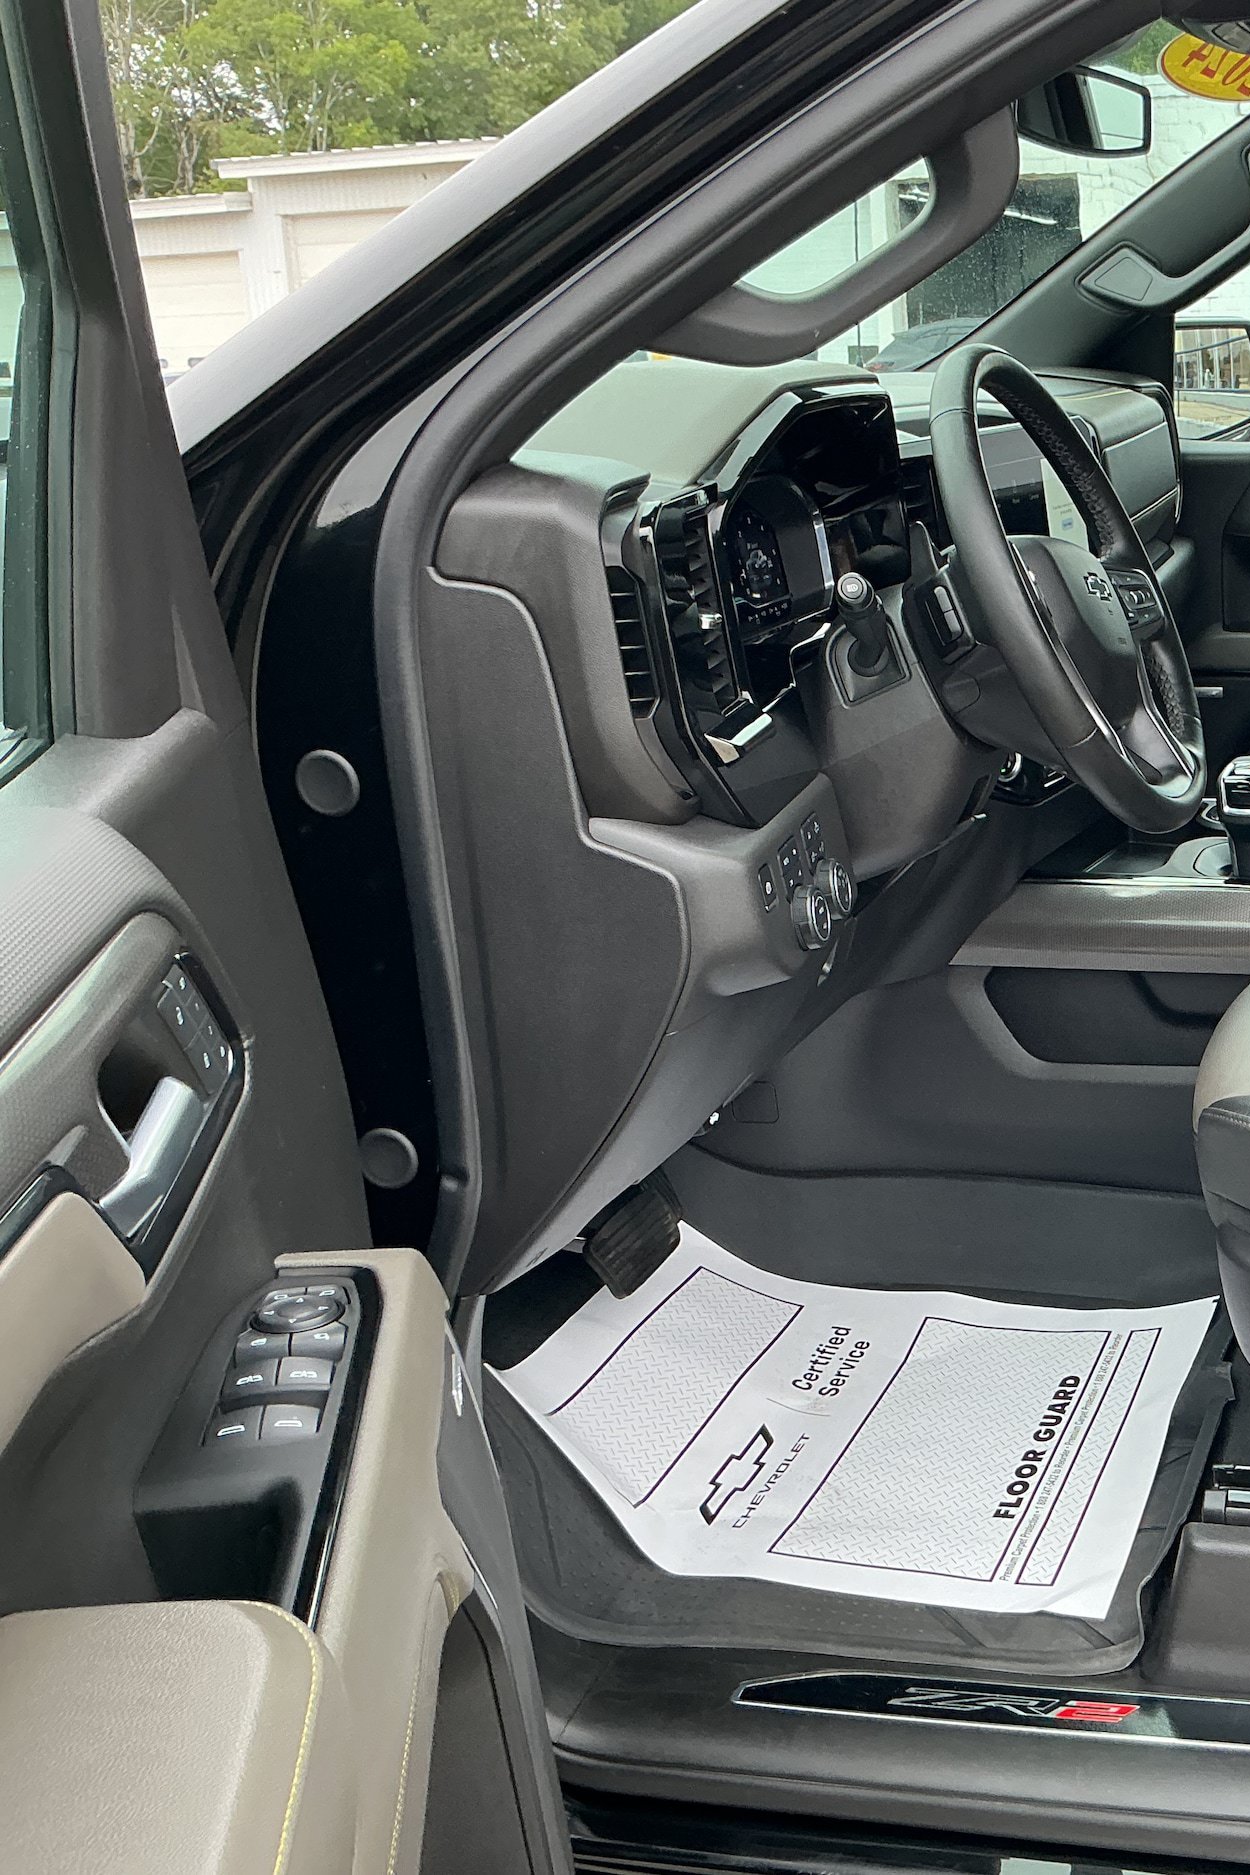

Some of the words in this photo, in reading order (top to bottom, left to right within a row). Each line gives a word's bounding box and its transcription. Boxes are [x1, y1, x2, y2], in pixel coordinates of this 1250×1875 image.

[792, 1326, 852, 1391] Certified
[818, 1340, 870, 1397] Service
[993, 1449, 1047, 1519] FLOOR
[1033, 1375, 1081, 1442] GUARD
[732, 1433, 810, 1528] CHEVROLET
[1011, 1537, 1028, 1556] Carpet
